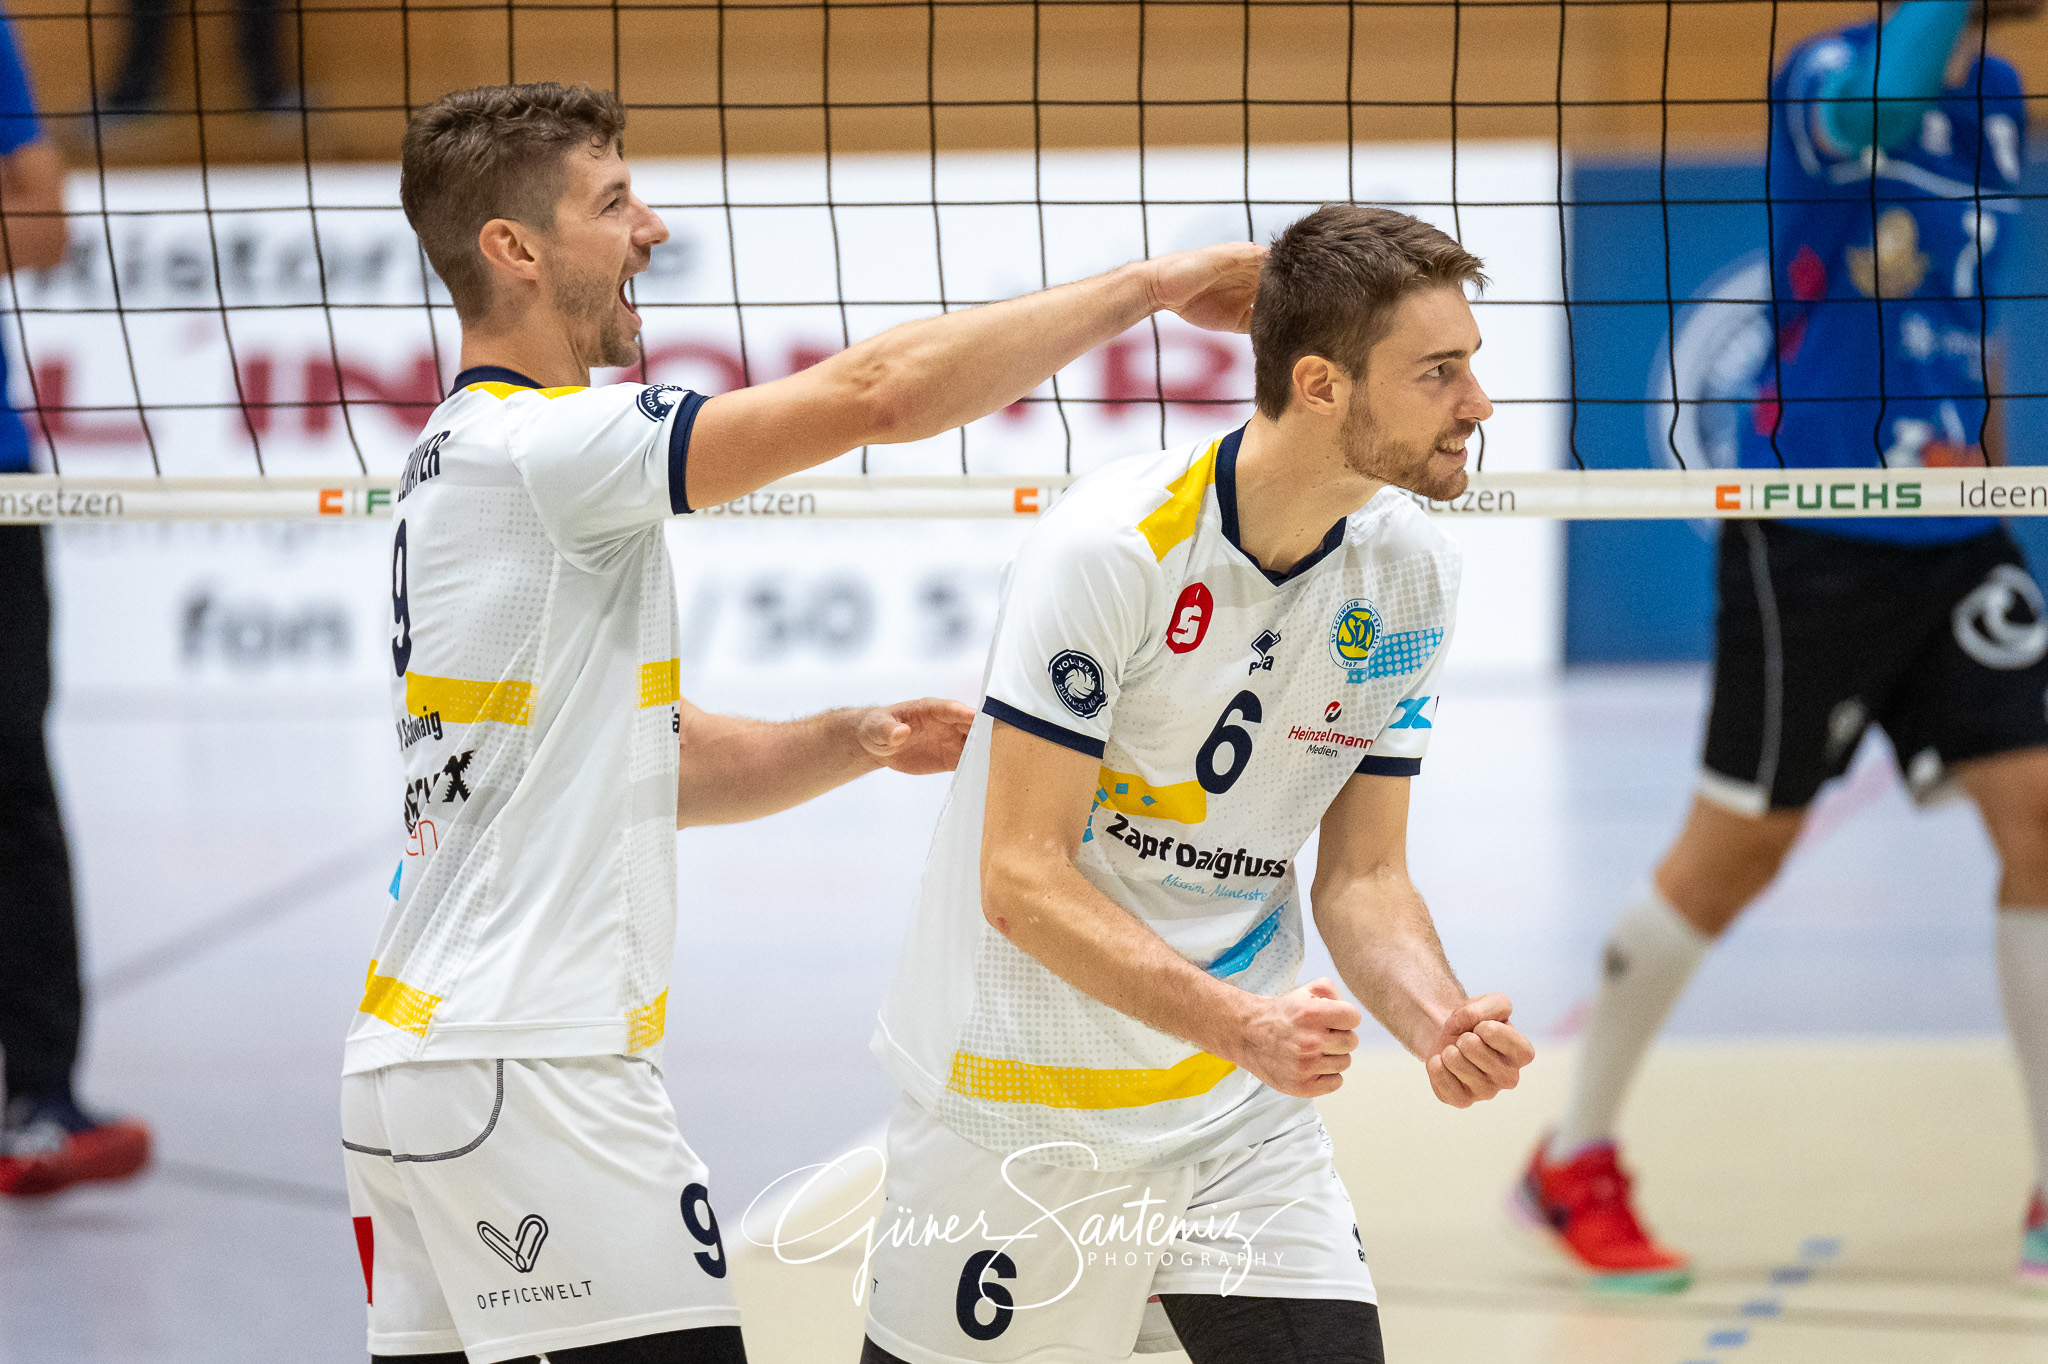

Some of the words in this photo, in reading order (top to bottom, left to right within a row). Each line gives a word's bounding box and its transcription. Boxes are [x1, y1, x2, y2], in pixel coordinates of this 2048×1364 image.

[703, 491, 816, 516] setzen
[1763, 482, 1922, 510] FUCHS
[1959, 478, 2048, 508] Ideen
[392, 518, 412, 678] 9
[1333, 601, 1360, 631] SCHWAIG
[1342, 660, 1358, 669] 1967
[402, 705, 443, 747] Schwaig
[1288, 725, 1375, 750] Heinzelmann
[1196, 690, 1262, 795] 6
[1306, 744, 1338, 758] Medien
[1105, 812, 1175, 860] Zapf
[1175, 842, 1288, 879] Daigfuss
[1161, 873, 1206, 895] Mission
[680, 1183, 727, 1279] 9
[476, 1280, 592, 1310] OFFICEWELT
[956, 1249, 1017, 1341] 6
